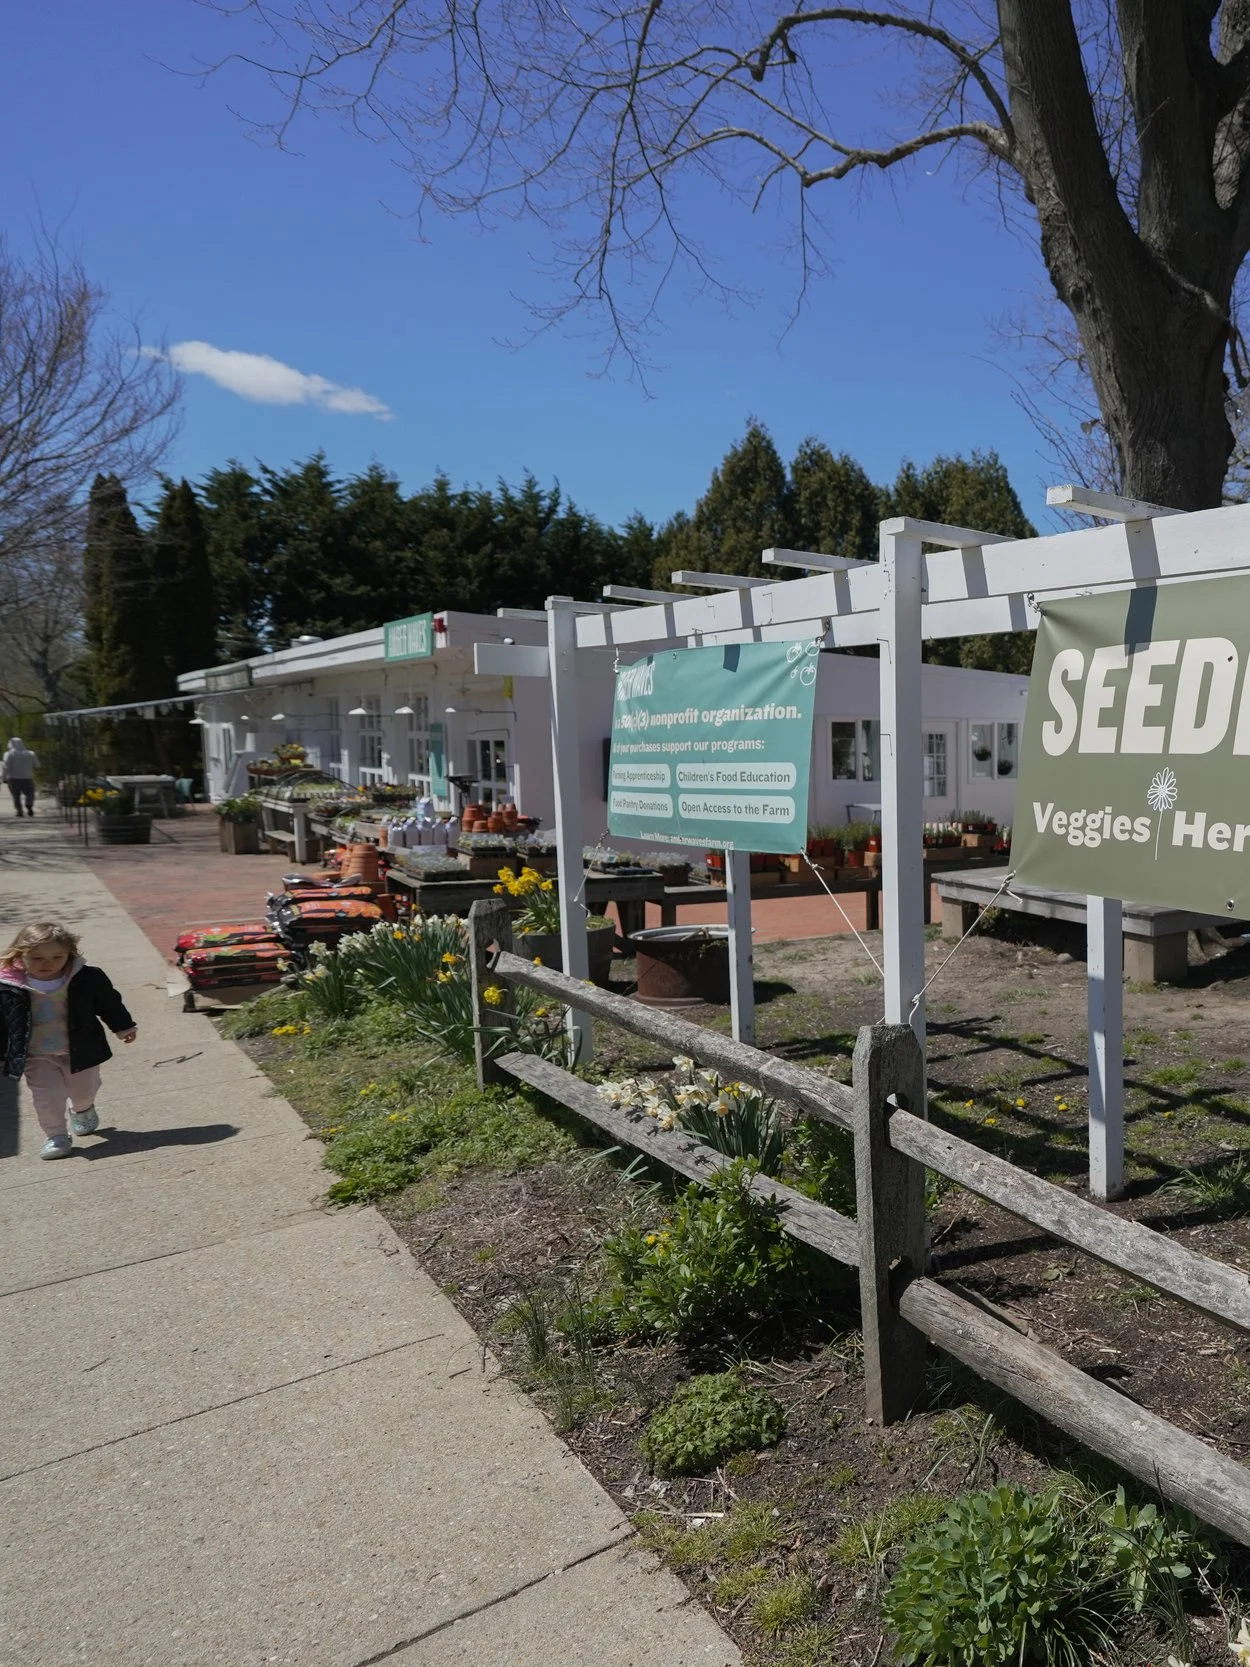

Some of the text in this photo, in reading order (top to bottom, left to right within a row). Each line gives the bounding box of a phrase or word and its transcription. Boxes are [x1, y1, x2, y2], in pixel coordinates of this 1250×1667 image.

[650, 708, 699, 729] nonprofit
[702, 703, 802, 727] organization.
[630, 741, 660, 755] purchases
[661, 740, 691, 754] support
[693, 741, 709, 751] our
[711, 739, 765, 754] programs:
[626, 771, 666, 782] Apprenticeship
[678, 771, 791, 783] Children's Food Education
[623, 799, 638, 811] Pantry
[639, 800, 668, 811] Donations
[681, 802, 790, 816] Open Access to the Farm
[1031, 802, 1151, 849] Veggies
[640, 831, 654, 841] Learn
